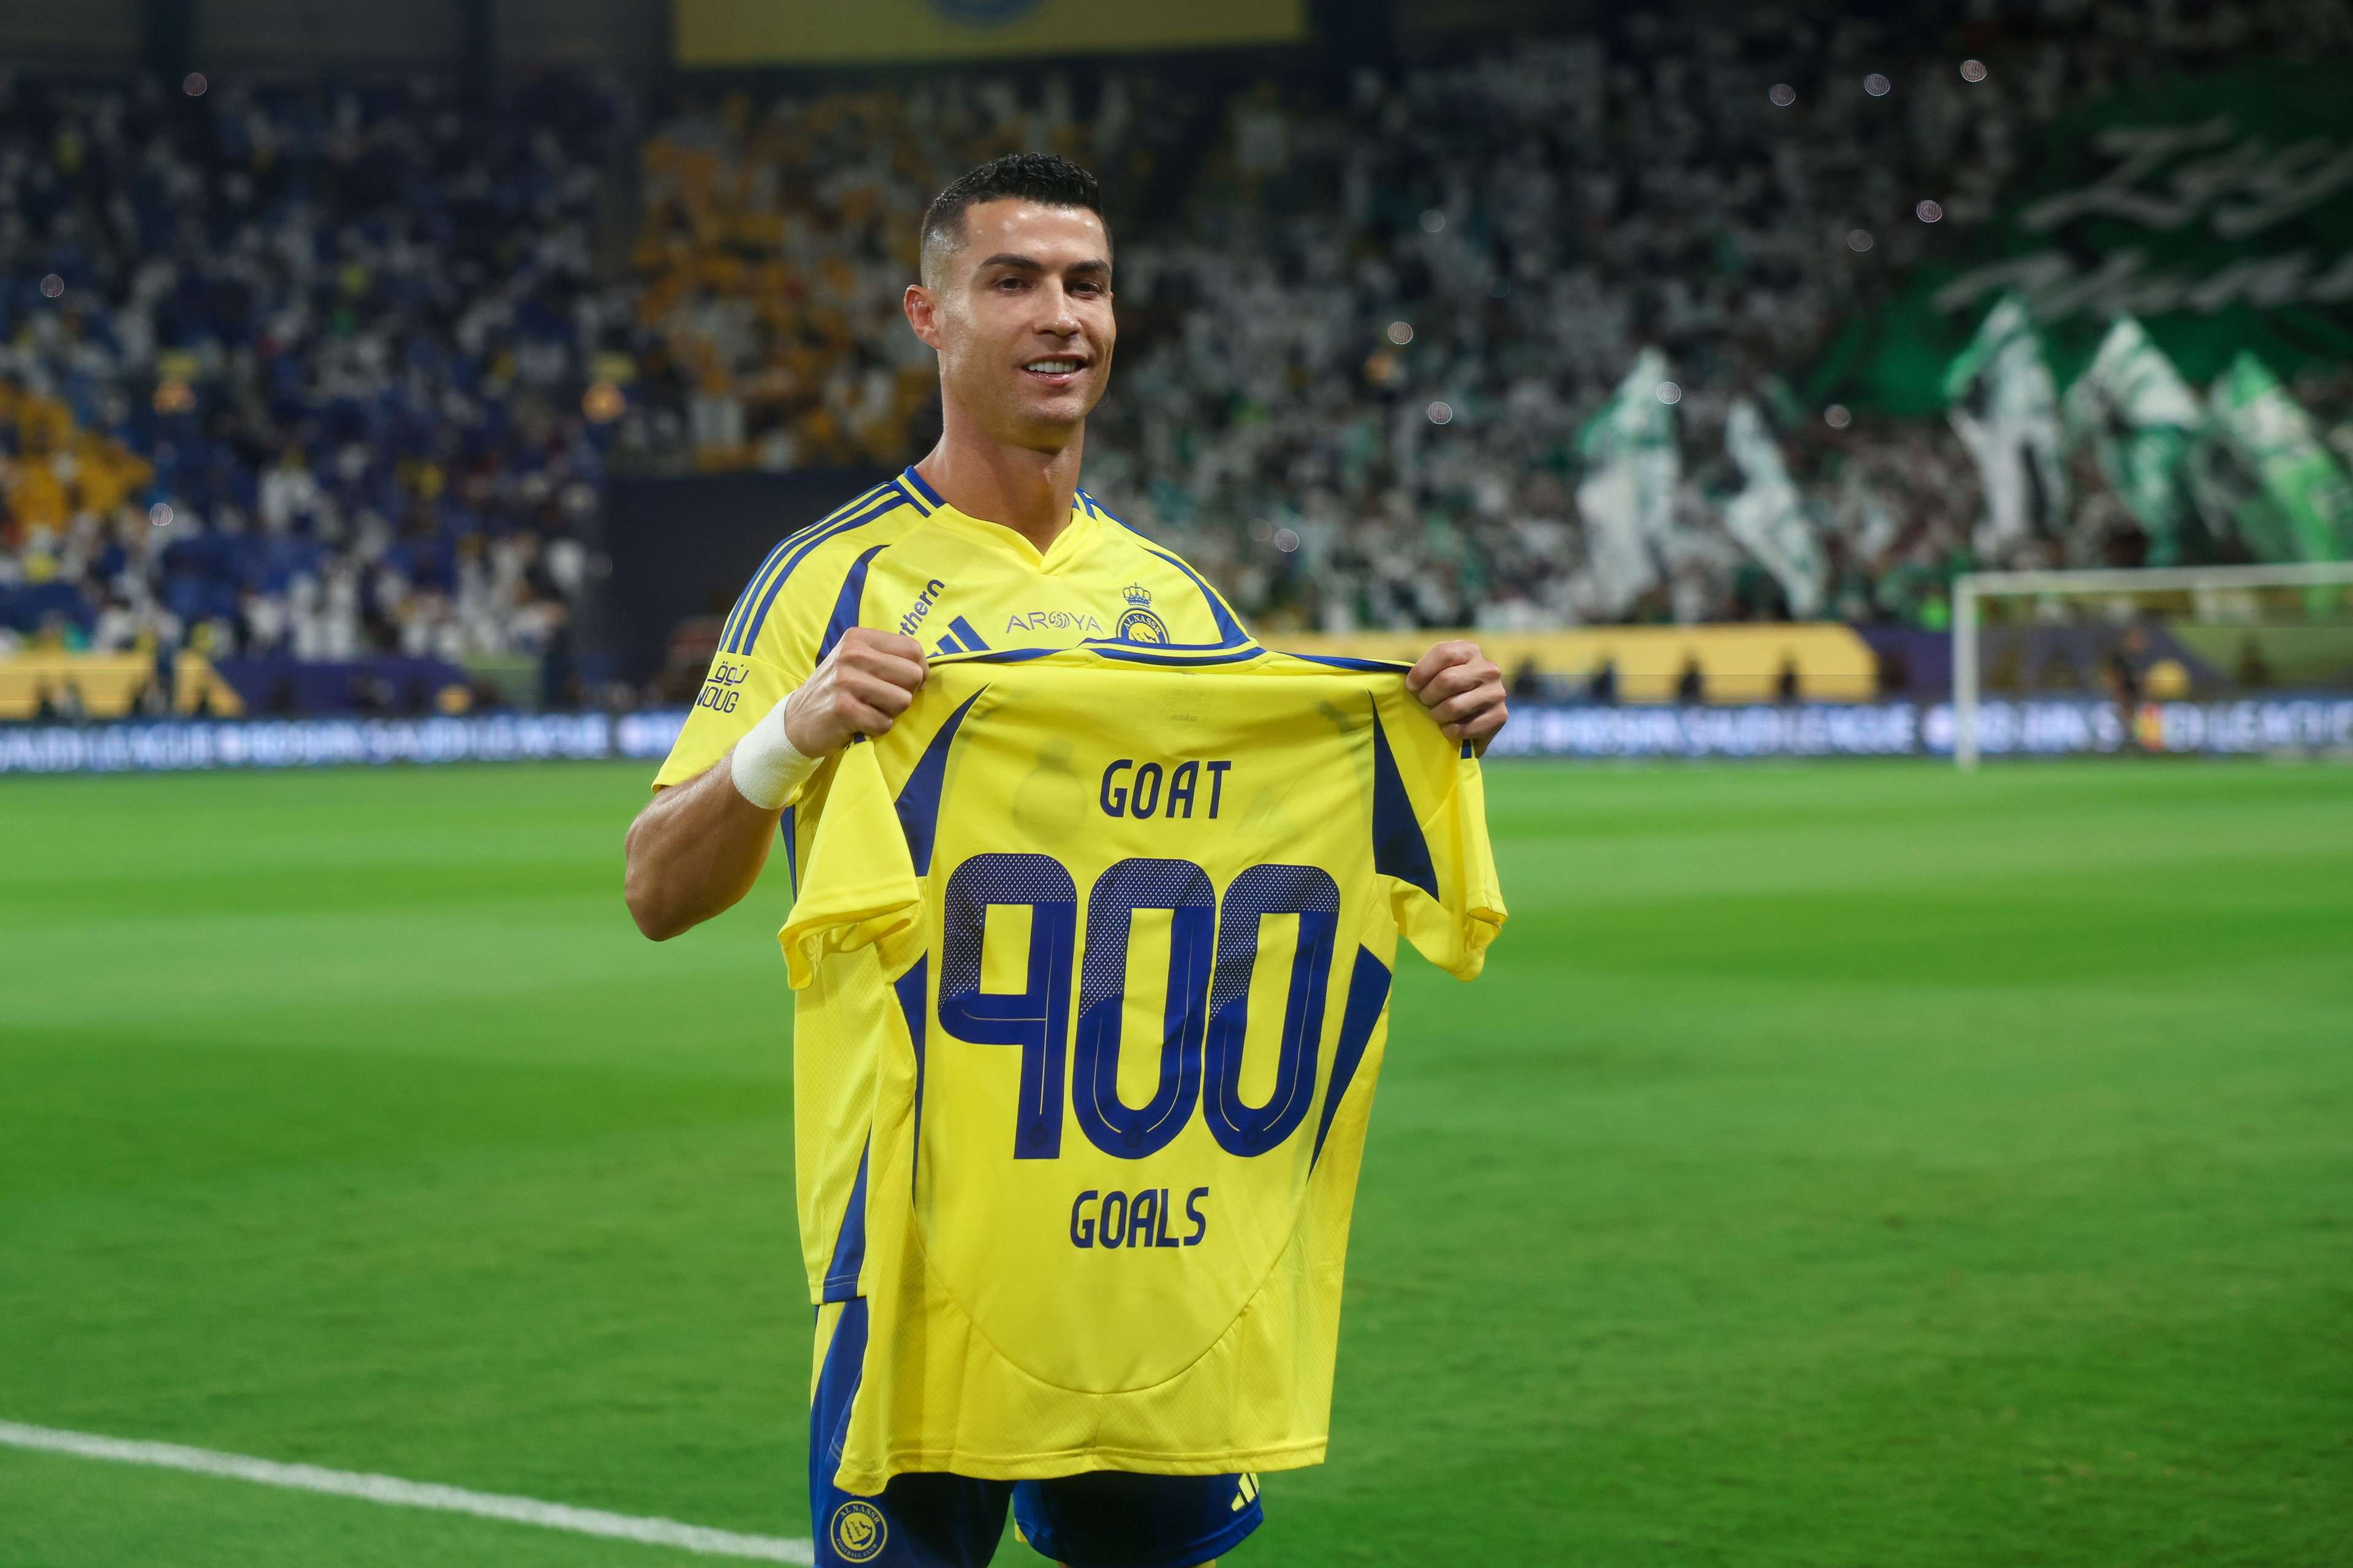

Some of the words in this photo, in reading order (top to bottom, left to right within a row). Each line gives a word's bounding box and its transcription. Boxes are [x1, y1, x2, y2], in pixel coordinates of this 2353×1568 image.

[899, 579, 945, 636] thern
[1006, 611, 1104, 634] AROYA
[1123, 618, 1134, 631] AL
[1133, 614, 1161, 635] NASSR
[1099, 759, 1232, 820] GOAT
[938, 852, 1341, 1160] 900
[1070, 1186, 1209, 1249] GOALS
